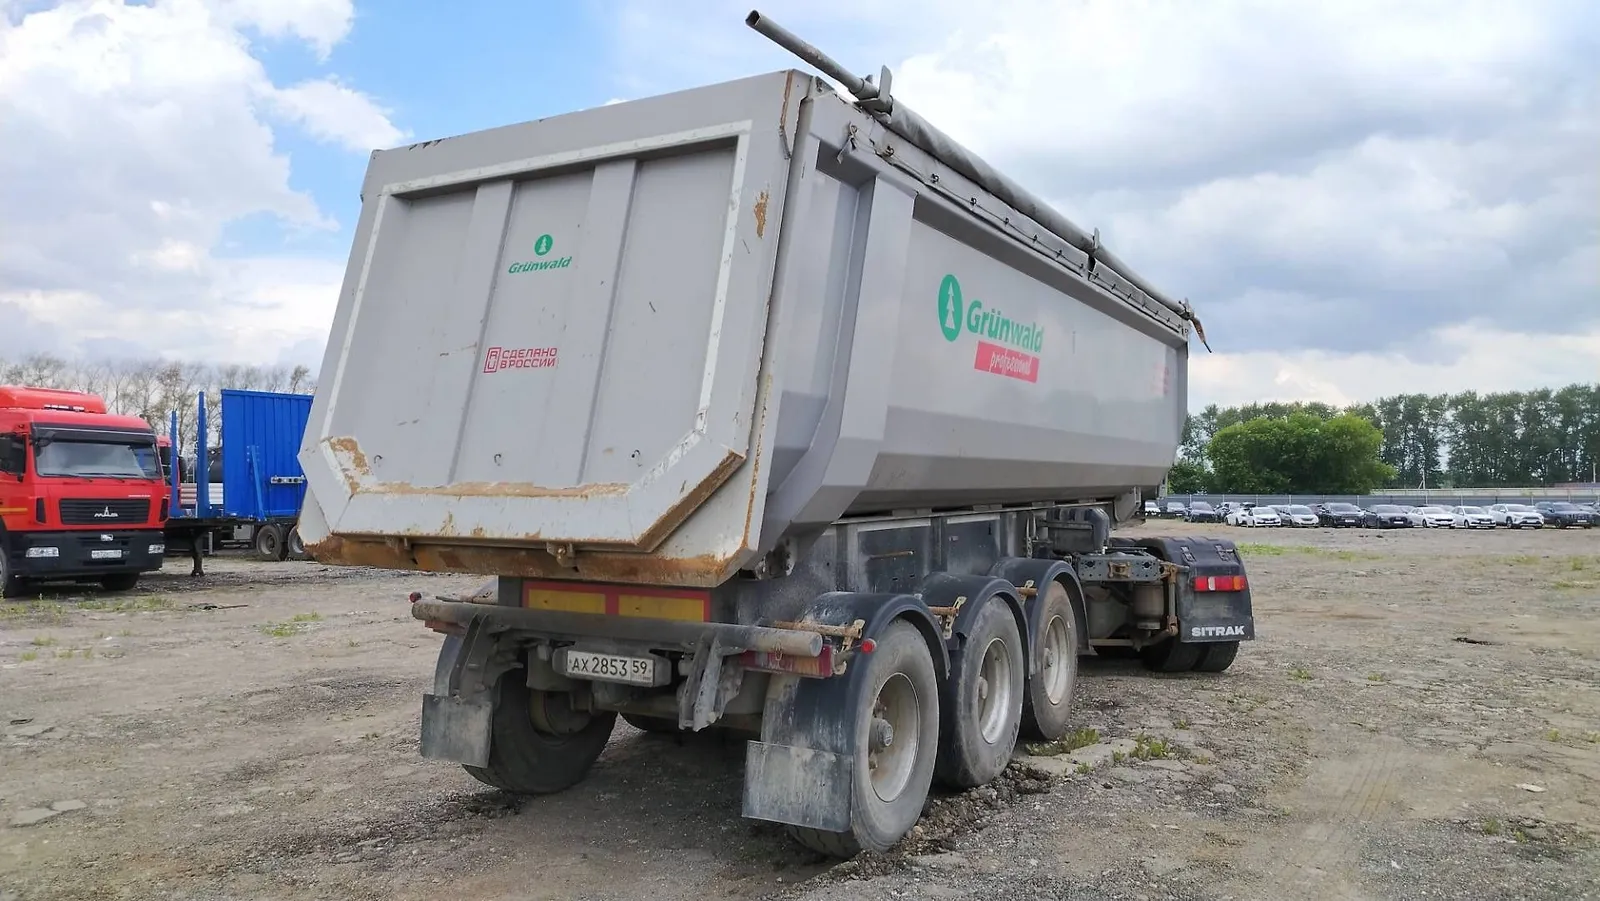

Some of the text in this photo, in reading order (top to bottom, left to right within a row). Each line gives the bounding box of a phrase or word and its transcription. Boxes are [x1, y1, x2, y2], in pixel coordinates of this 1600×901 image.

[508, 256, 572, 274] Grünwald
[967, 300, 1044, 353] Grünwald
[502, 347, 558, 359] СДЕЛАНО
[1191, 626, 1245, 637] SITRAK
[591, 657, 628, 677] 2853
[632, 660, 648, 674] 59
